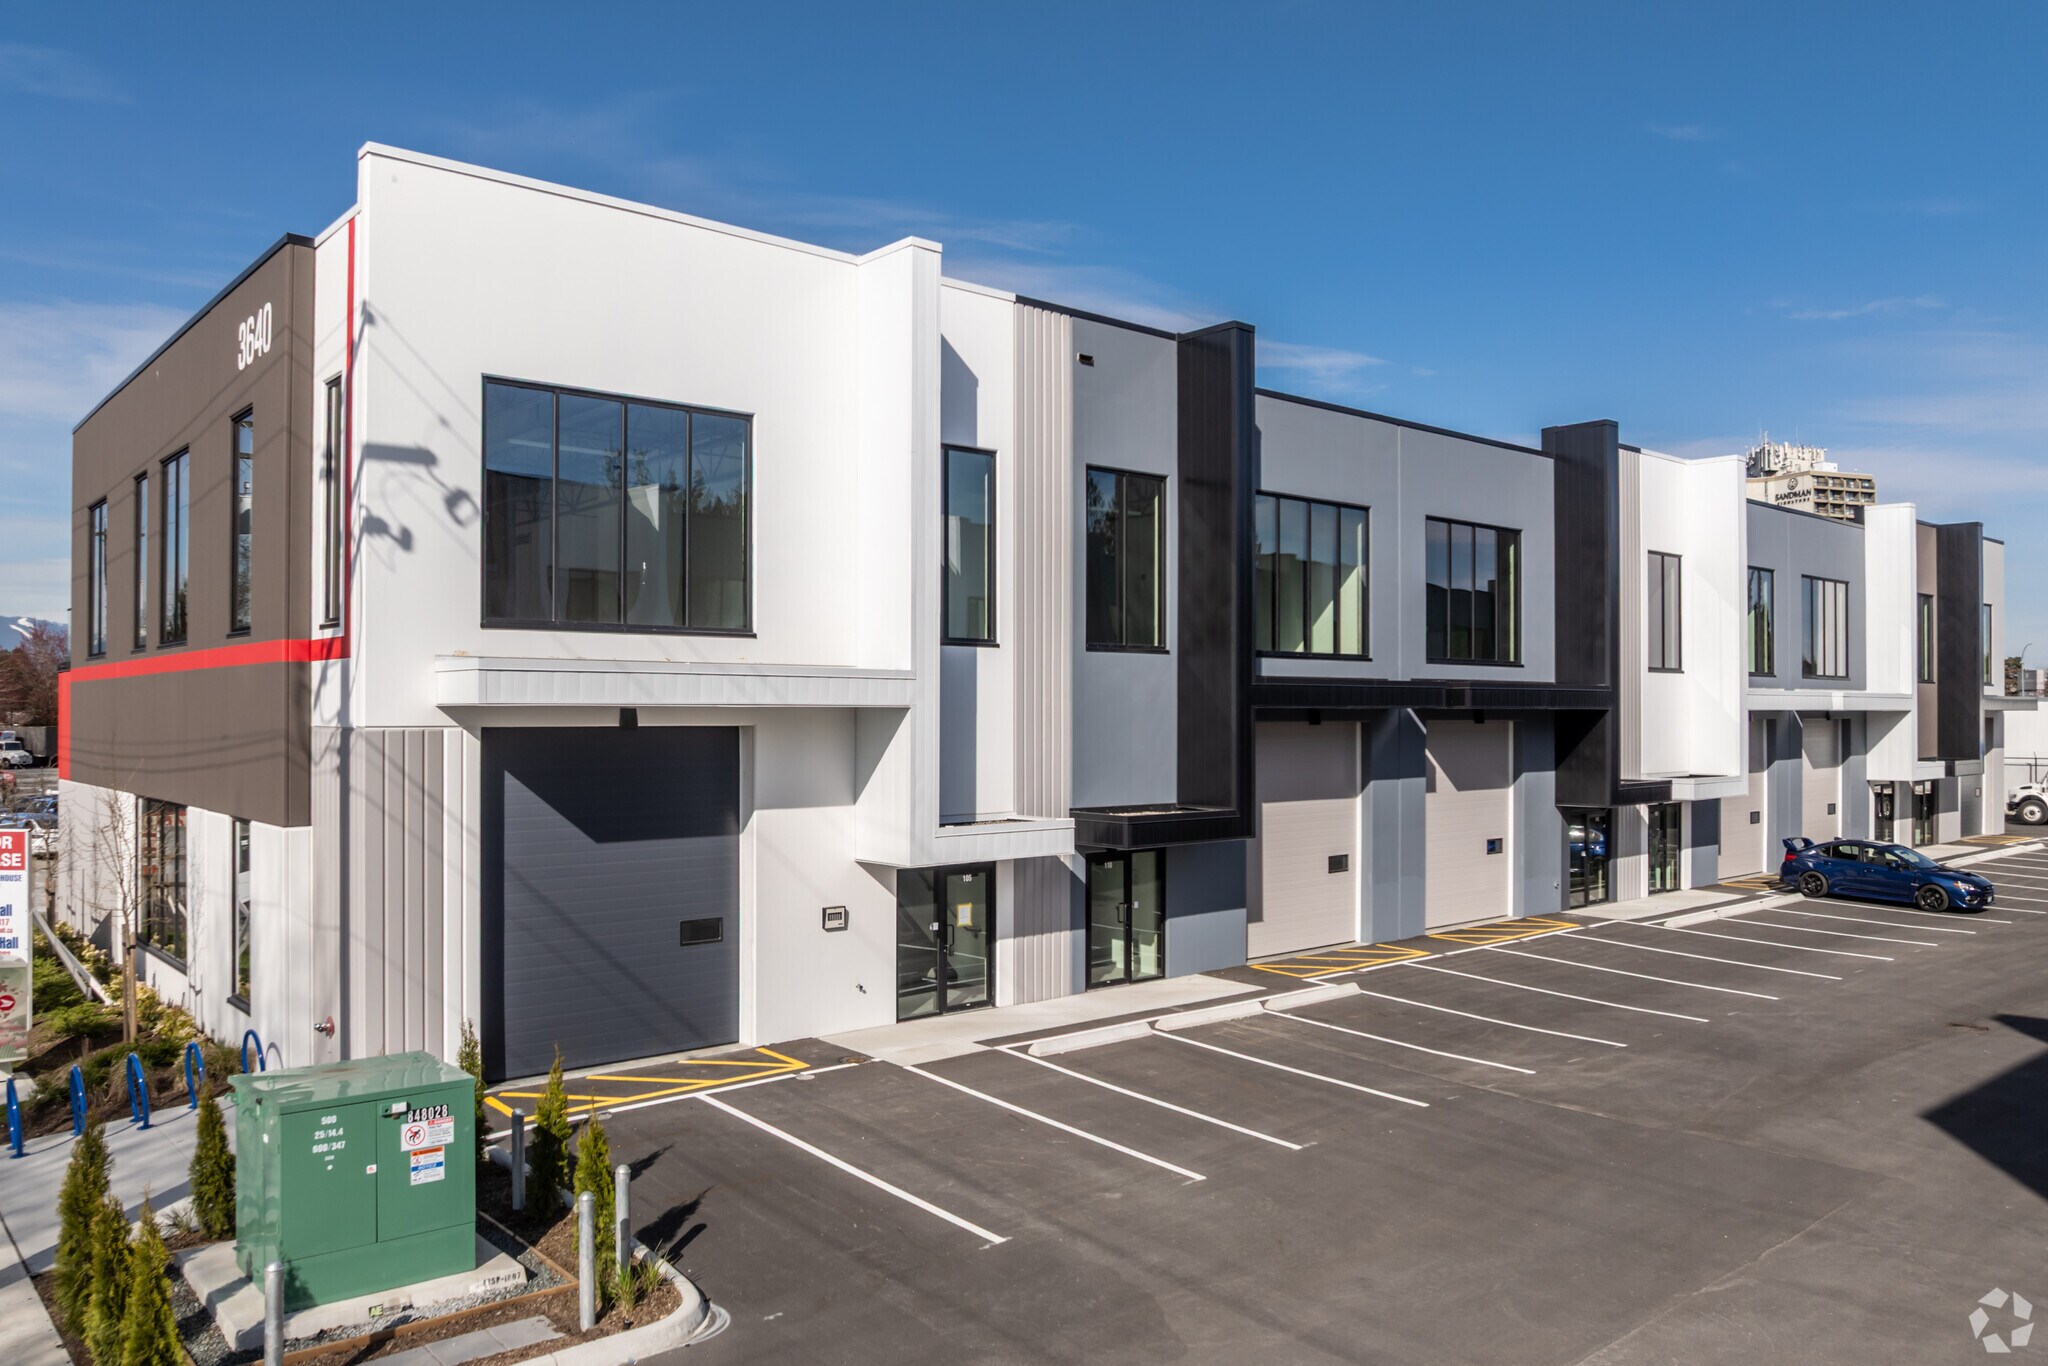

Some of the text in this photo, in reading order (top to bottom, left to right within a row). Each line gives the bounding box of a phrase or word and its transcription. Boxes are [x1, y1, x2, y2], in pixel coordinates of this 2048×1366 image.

[238, 302, 272, 371] 3640
[1775, 489, 1812, 501] SANDMAN
[962, 874, 973, 882] 105
[407, 1104, 449, 1123] 848028
